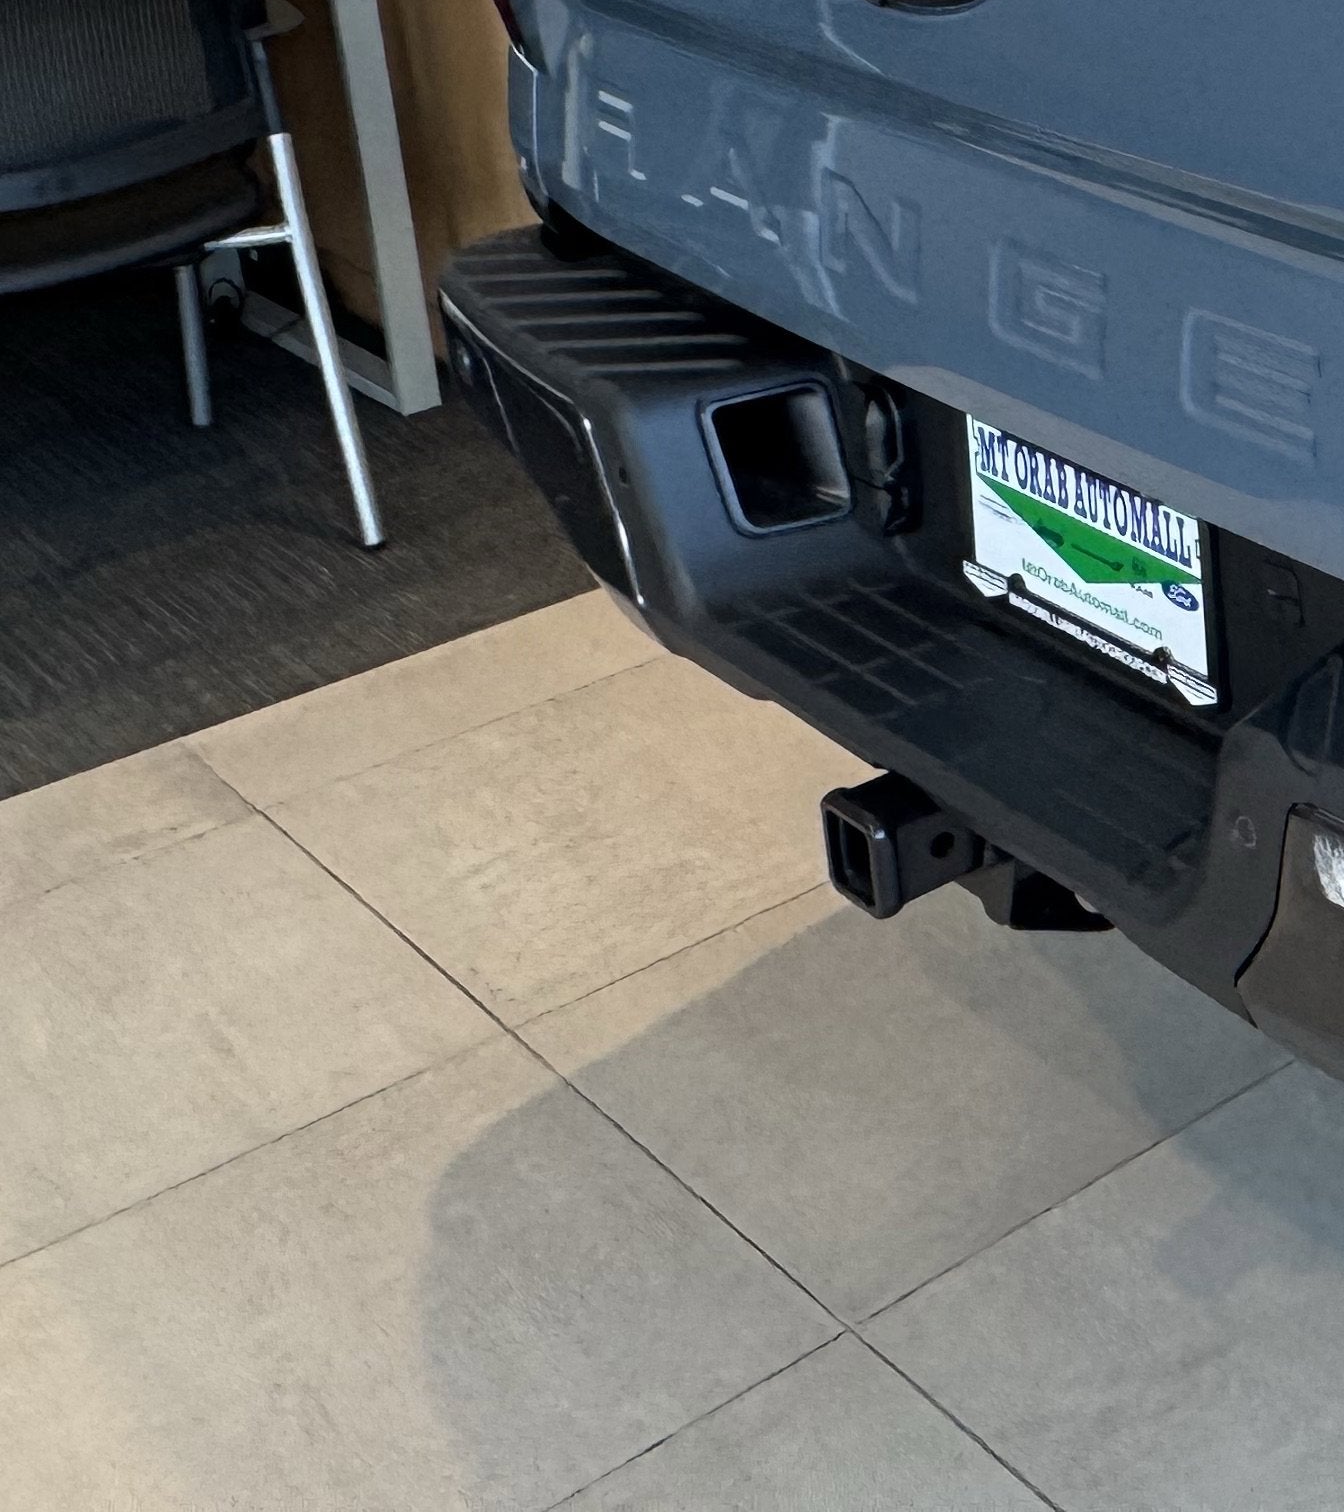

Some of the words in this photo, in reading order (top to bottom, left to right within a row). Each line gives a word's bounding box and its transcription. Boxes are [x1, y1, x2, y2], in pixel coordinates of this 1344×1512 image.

[976, 426, 1010, 482] MT
[1014, 443, 1069, 510] ORAB
[1073, 466, 1193, 569] AUTOMALL
